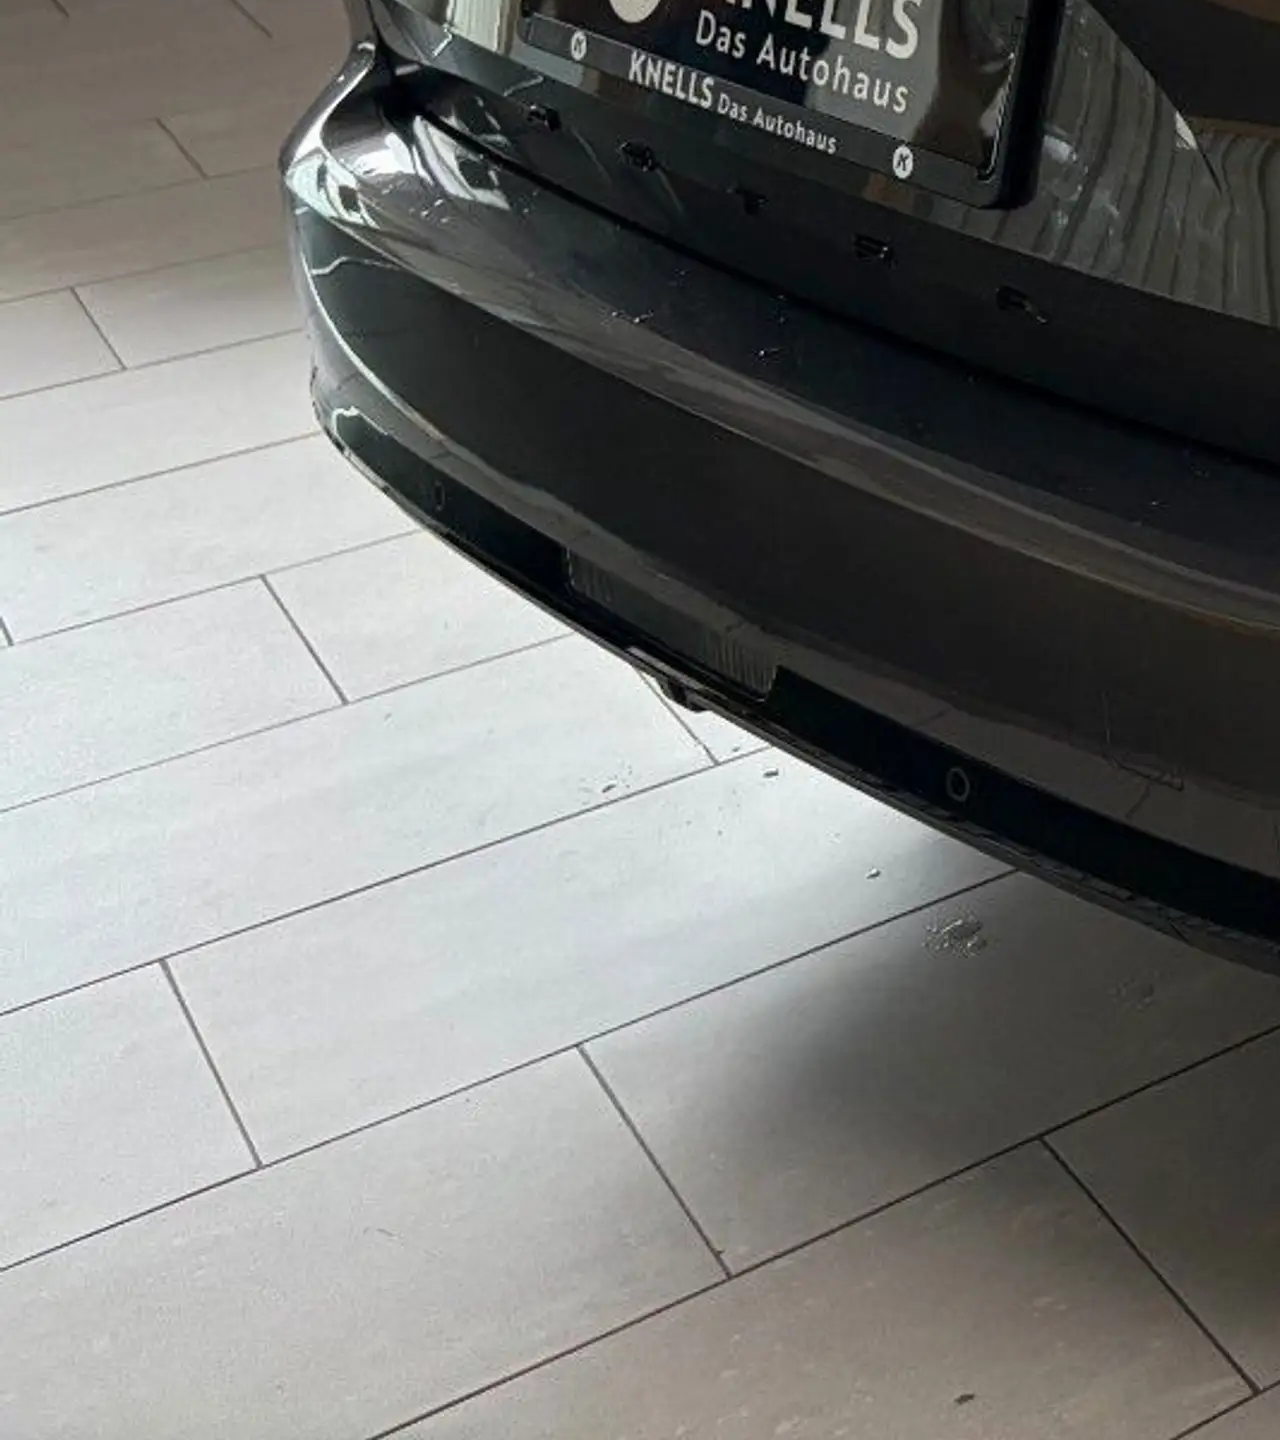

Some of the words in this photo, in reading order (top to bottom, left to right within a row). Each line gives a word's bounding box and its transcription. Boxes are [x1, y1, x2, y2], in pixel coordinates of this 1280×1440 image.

[628, 50, 715, 110] KNELLS
[717, 92, 748, 123] Das
[752, 107, 838, 155] Autohaus
[695, 10, 746, 59] Das
[756, 33, 909, 113] Autohaus
